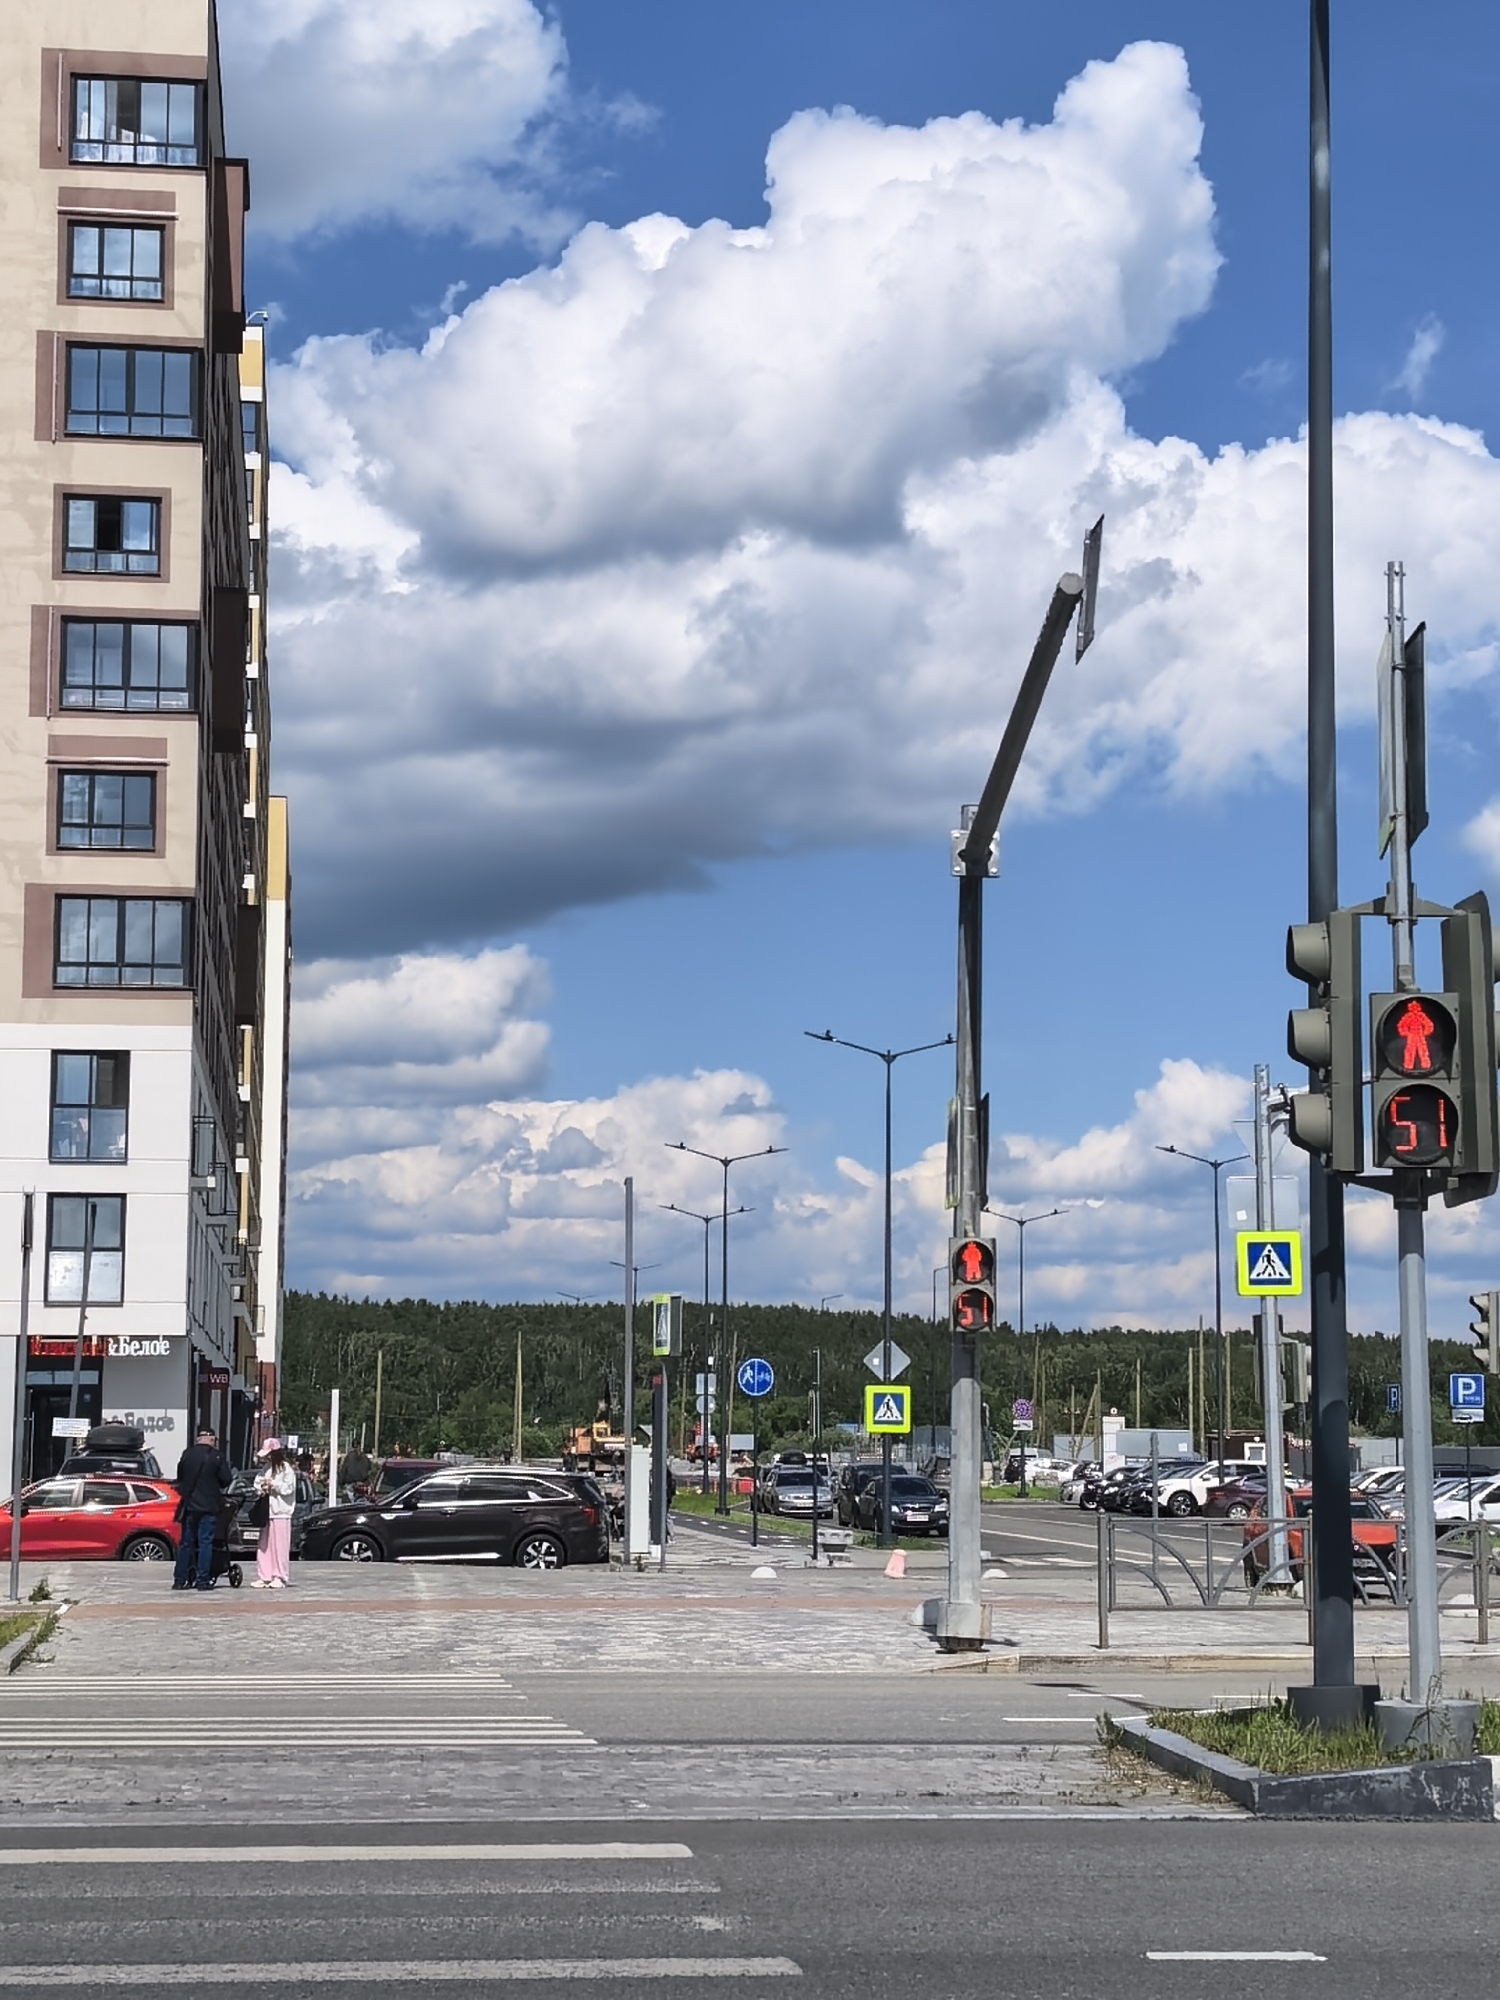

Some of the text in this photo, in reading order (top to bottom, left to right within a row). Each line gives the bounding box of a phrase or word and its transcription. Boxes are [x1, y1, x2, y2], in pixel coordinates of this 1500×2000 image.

[1390, 1096, 1447, 1151] 51
[958, 1293, 988, 1326] 51
[209, 1373, 228, 1383] WB
[1457, 1377, 1477, 1403] P
